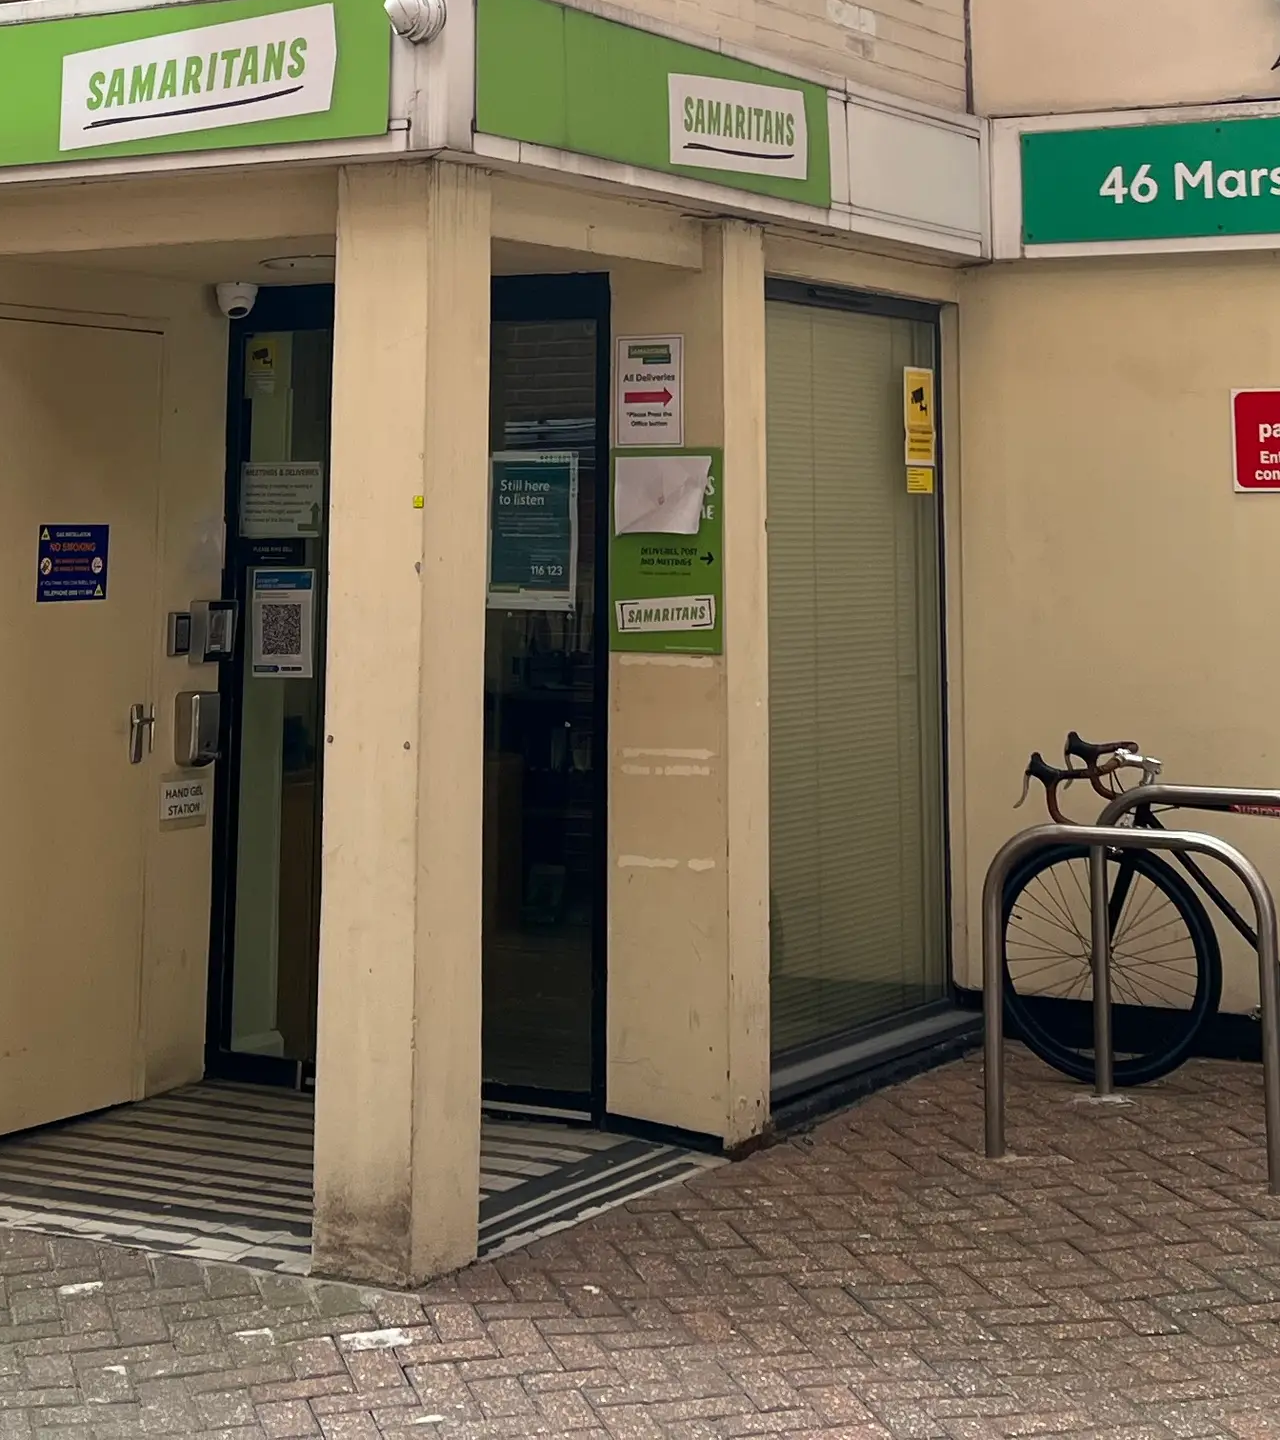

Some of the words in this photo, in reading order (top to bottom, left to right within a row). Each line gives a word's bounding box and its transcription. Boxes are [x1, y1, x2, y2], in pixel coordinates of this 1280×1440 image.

[86, 36, 309, 110] SAMARITANS
[682, 95, 796, 146] SAMARITANS
[1098, 162, 1158, 205] 46
[623, 374, 634, 382] All
[636, 373, 675, 382] Deliveries
[500, 479, 522, 492] Still
[524, 480, 550, 491] here
[499, 495, 511, 505] to
[514, 493, 545, 506] listen
[531, 566, 545, 576] 116
[547, 565, 563, 576] 123
[628, 606, 705, 623] SAMARITANS
[165, 786, 189, 799] HAND
[167, 802, 201, 816] STATION
